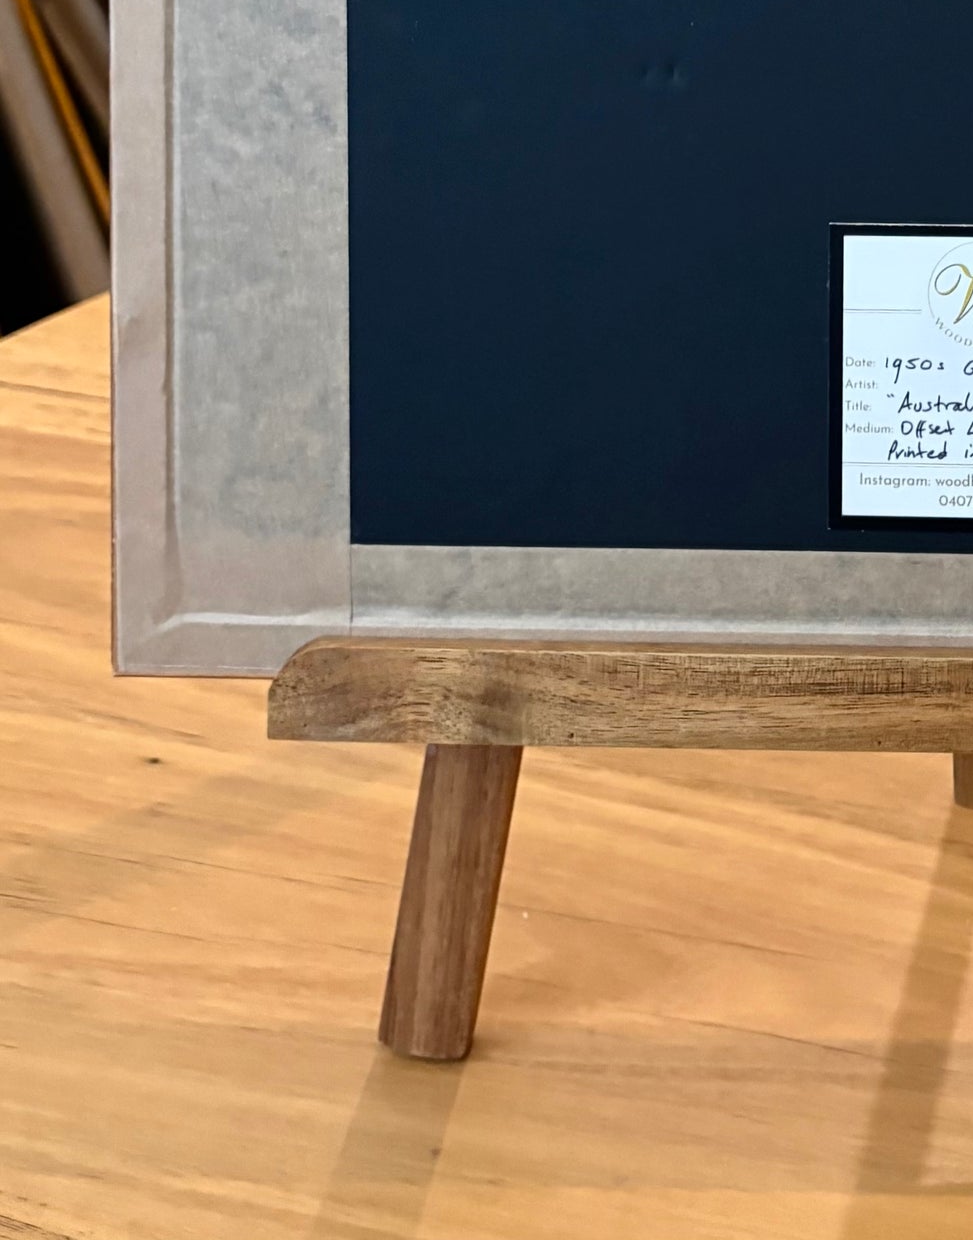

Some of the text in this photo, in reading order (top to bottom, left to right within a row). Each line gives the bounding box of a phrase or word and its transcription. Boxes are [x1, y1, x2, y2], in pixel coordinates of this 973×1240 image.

[845, 356, 876, 368] Date:
[885, 357, 945, 385] 1950s
[845, 379, 879, 390] Artist:
[846, 400, 872, 412] Title:
[845, 422, 894, 434] Medium:
[900, 419, 955, 439] Offset
[887, 439, 948, 461] Printed
[859, 472, 931, 489] Instagram:
